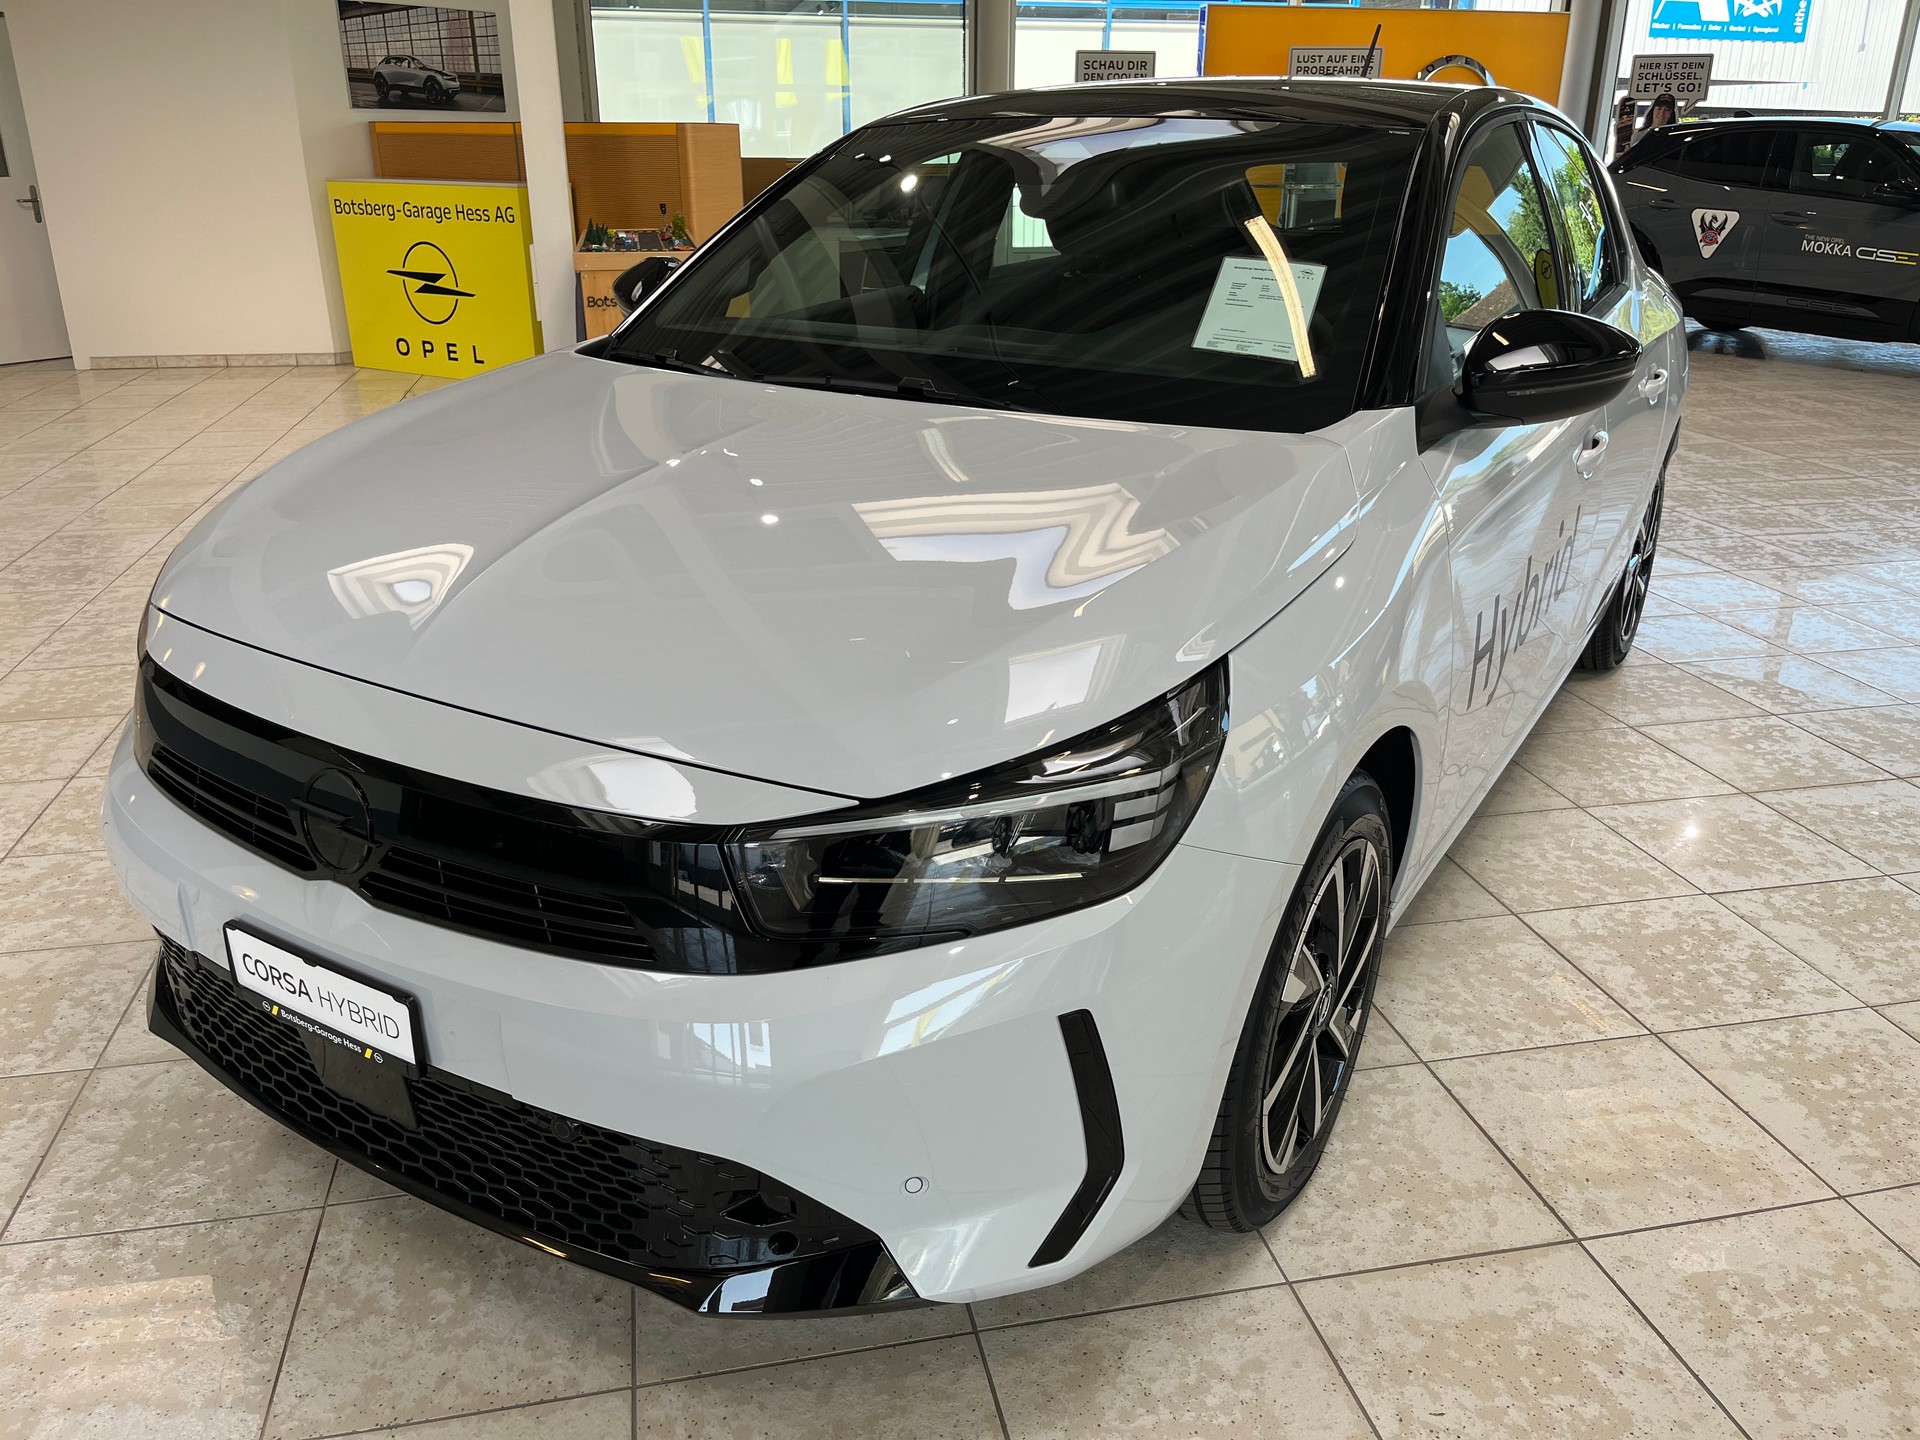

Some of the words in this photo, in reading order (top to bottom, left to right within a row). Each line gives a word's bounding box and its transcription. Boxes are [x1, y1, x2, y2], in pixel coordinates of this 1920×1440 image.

[1083, 60, 1124, 71] SCHAU
[1127, 60, 1148, 71] DIR
[1296, 55, 1323, 64] LUST
[1326, 55, 1348, 64] AUF
[1639, 62, 1662, 70] HIER
[1664, 62, 1680, 70] IST
[1682, 62, 1705, 70] DEIN
[1083, 73, 1104, 81] DEN
[1637, 70, 1702, 81] SCHLÜSSEL.
[1677, 83, 1702, 93] GO!
[334, 199, 452, 224] Botsberg-Garage
[455, 204, 491, 222] Hess
[494, 206, 516, 223] AG
[1801, 239, 1852, 258] MOKKA
[587, 295, 617, 308] Bots
[396, 337, 485, 365] OPEL
[1466, 504, 1581, 711] Hybrid
[242, 953, 313, 1004] CORSA
[317, 986, 400, 1040] HYBRID
[280, 1008, 344, 1045] Botsberg-Garage
[342, 1037, 363, 1053] Hess
